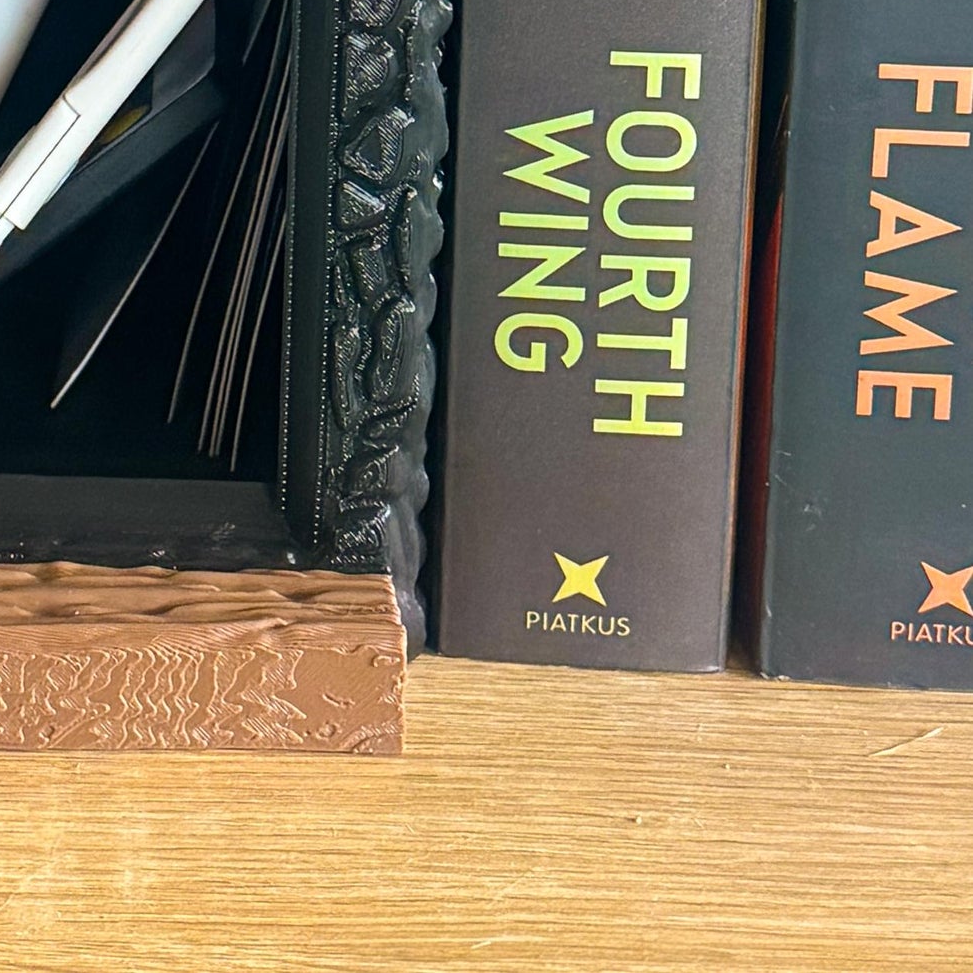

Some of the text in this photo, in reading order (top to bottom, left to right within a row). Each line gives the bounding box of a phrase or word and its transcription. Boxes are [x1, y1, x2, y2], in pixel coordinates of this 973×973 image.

[494, 109, 594, 373] WING
[593, 50, 703, 437] FOURTH
[856, 63, 973, 421] FLAME
[526, 611, 631, 636] PIATKUS
